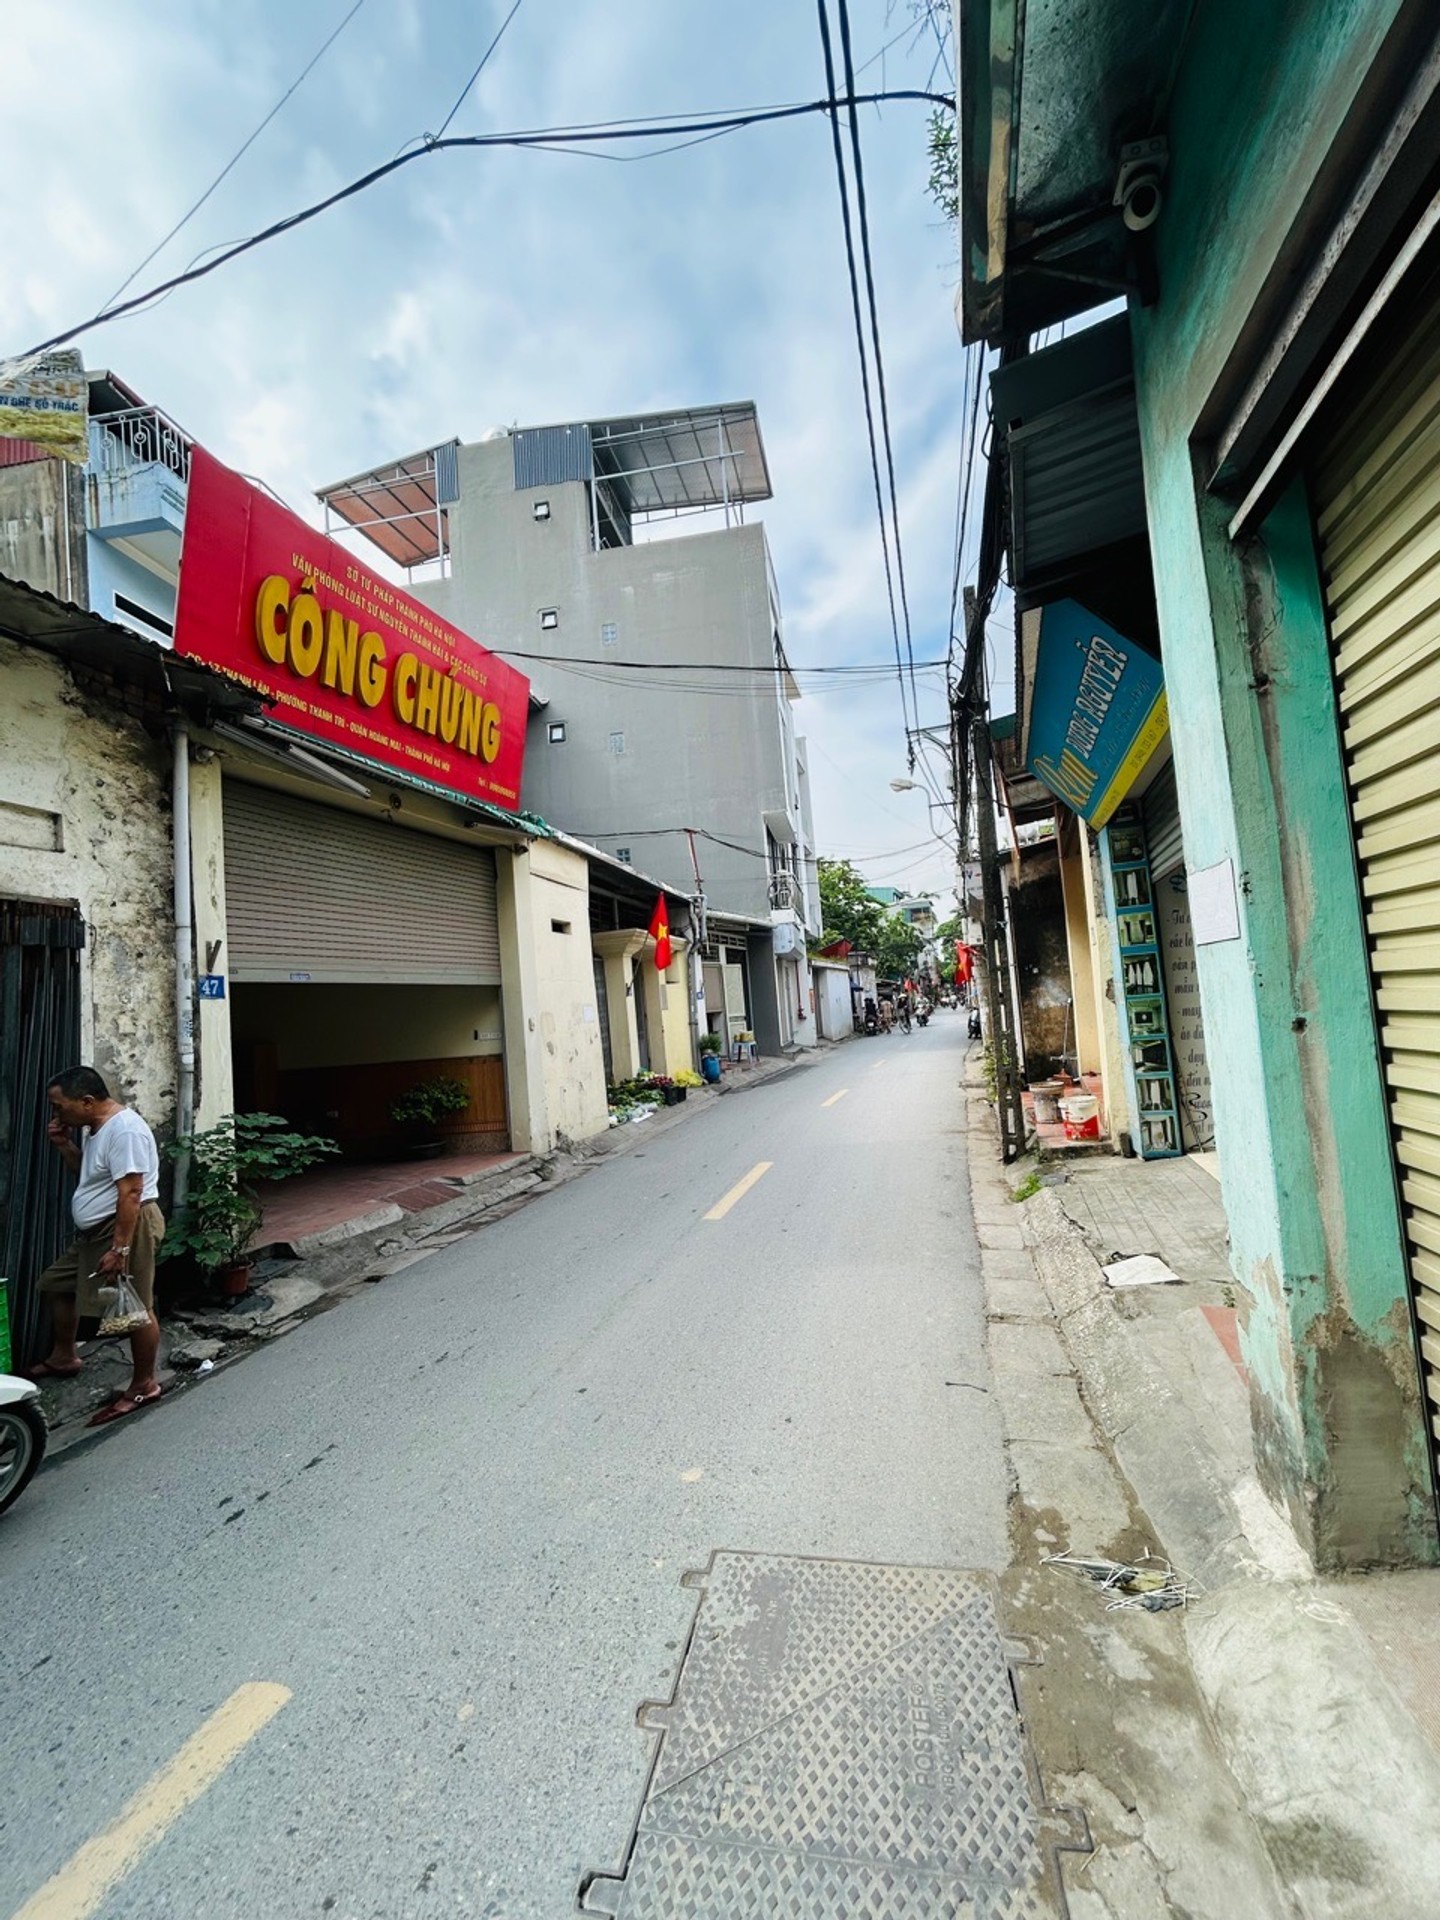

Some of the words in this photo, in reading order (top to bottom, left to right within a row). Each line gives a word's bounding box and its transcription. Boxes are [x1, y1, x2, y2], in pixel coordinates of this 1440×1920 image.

[292, 552, 312, 576] VĂN
[313, 566, 344, 597] PHÒNG
[345, 587, 366, 610] LUẬT
[256, 575, 387, 708] CÔNG
[393, 652, 501, 764] CHỨNG
[201, 979, 219, 996] 47
